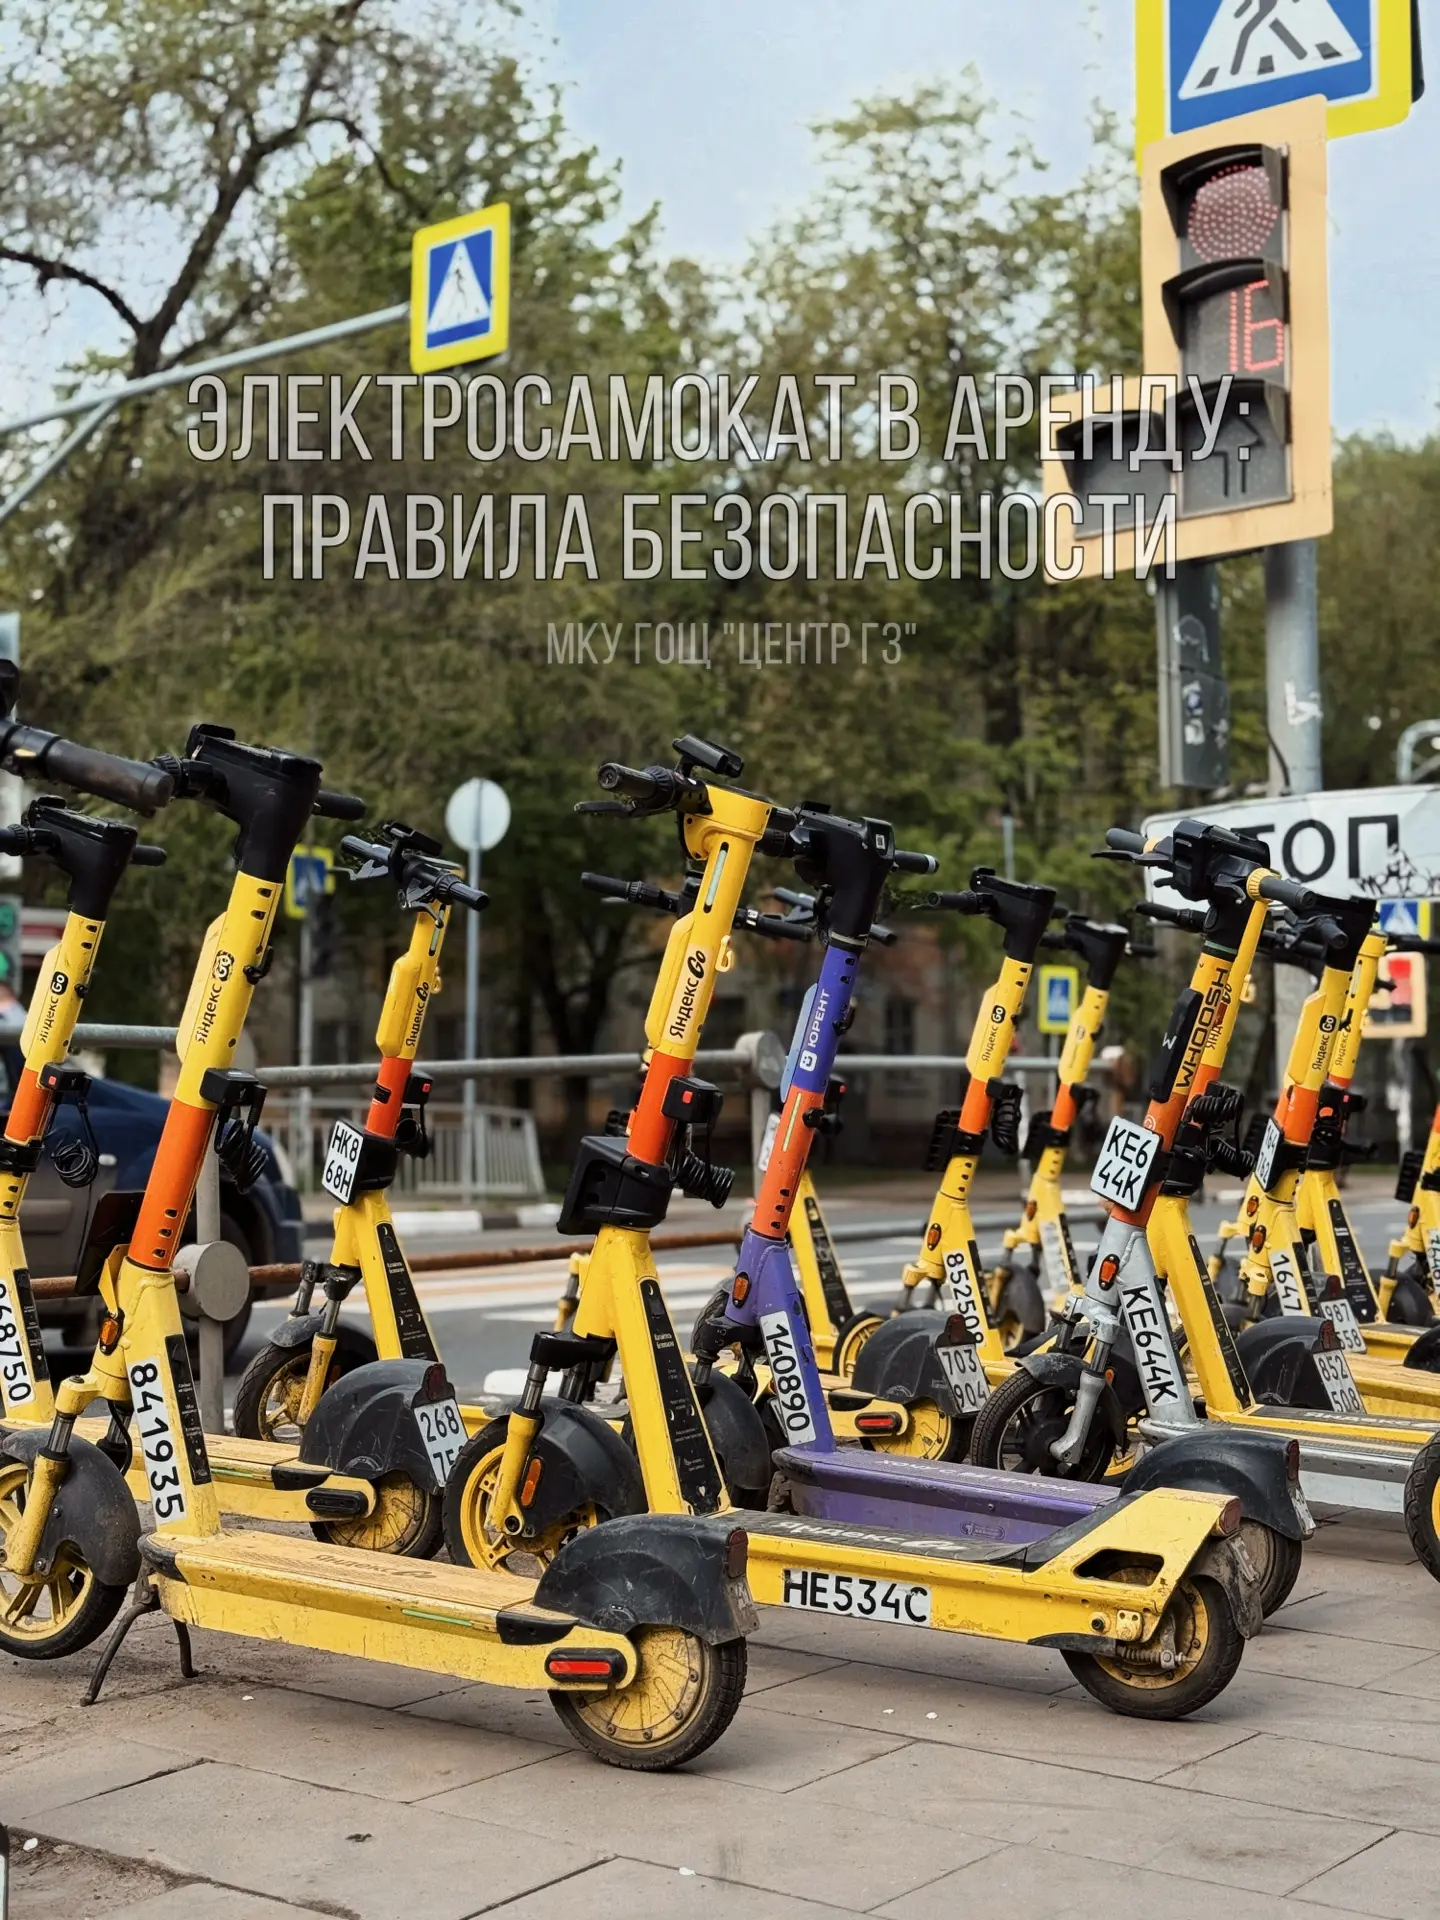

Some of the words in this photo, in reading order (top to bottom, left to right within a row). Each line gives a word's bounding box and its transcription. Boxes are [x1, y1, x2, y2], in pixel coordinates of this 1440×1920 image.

[1229, 279, 1285, 374] 16
[51, 973, 67, 994] Go
[670, 977, 699, 1038] Яндекс
[687, 950, 706, 979] Go
[406, 1001, 425, 1047] Яндекс
[416, 982, 430, 1002] Go
[807, 988, 830, 1048] ЮРЕНТ
[982, 1026, 999, 1062] Яндекс
[991, 1006, 1006, 1023] Go
[1176, 967, 1229, 1088] WHOOSH
[1321, 1016, 1335, 1032] Go
[1312, 1034, 1331, 1071] Яндекс
[941, 1349, 977, 1376] 703
[1122, 1285, 1178, 1403] КЕ644К
[1318, 1355, 1348, 1381] 852
[765, 1323, 810, 1432] 140890
[954, 1380, 987, 1408] 904
[130, 1362, 185, 1518] 841935
[420, 1405, 460, 1443] 268
[433, 1445, 464, 1482] 75
[772, 1521, 905, 1544] Яндекс
[783, 1569, 928, 1623] НЕ534С
